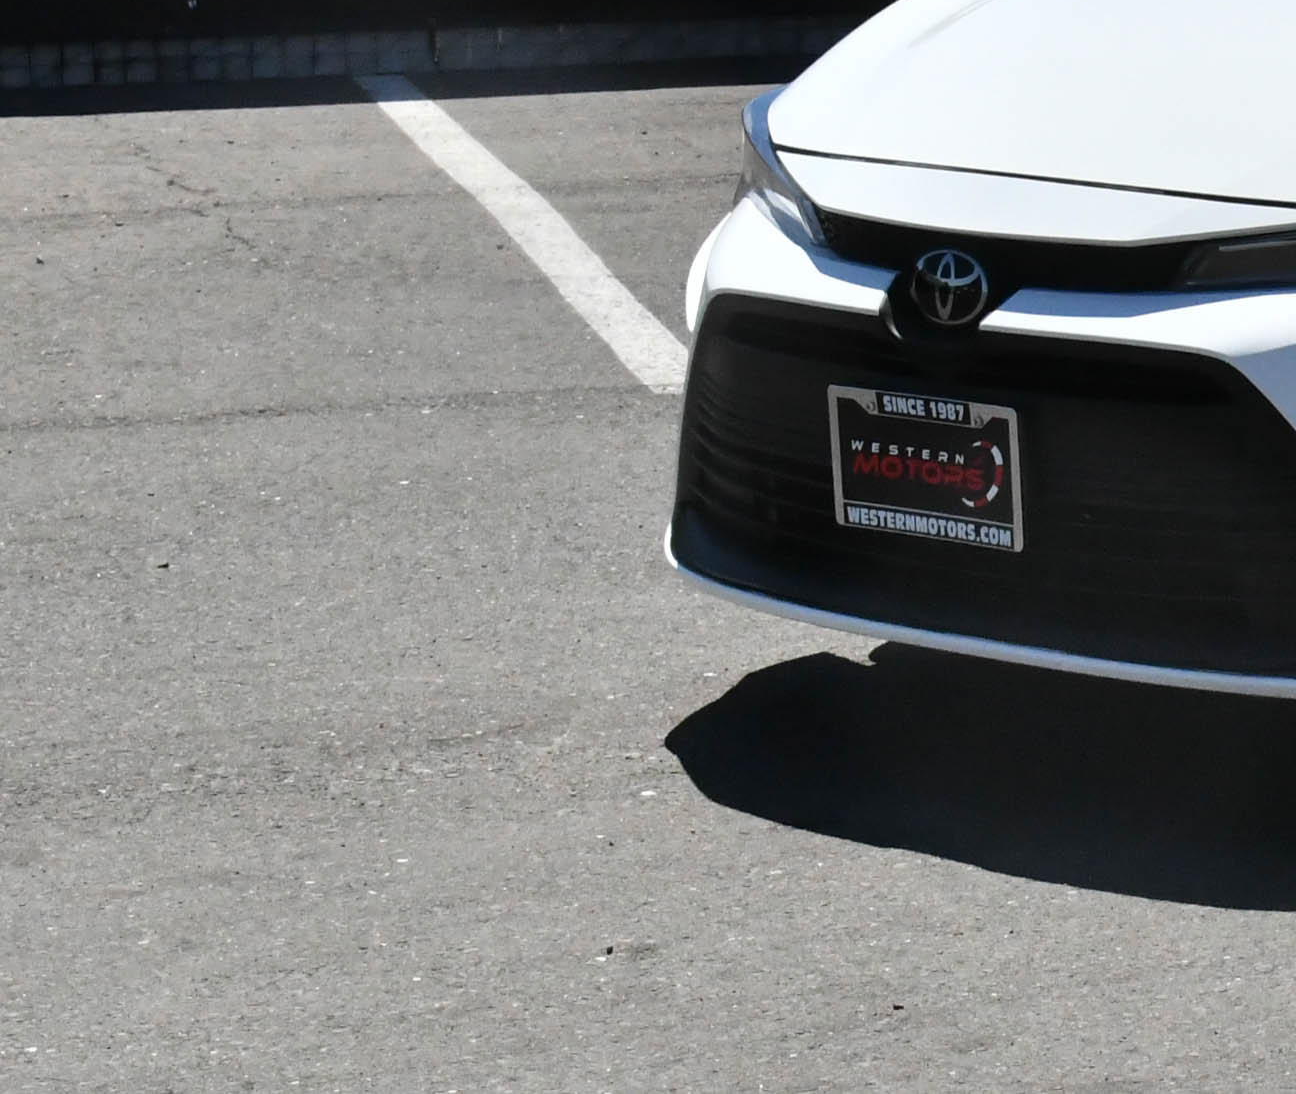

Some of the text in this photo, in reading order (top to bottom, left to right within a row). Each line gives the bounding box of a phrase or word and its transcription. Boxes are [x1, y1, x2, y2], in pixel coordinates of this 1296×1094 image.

[883, 395, 965, 420] SINCE 1987
[851, 439, 965, 465] WESTERN
[853, 453, 985, 491] MOTORS
[847, 505, 1012, 547] WESTERNMOTORS.COM
